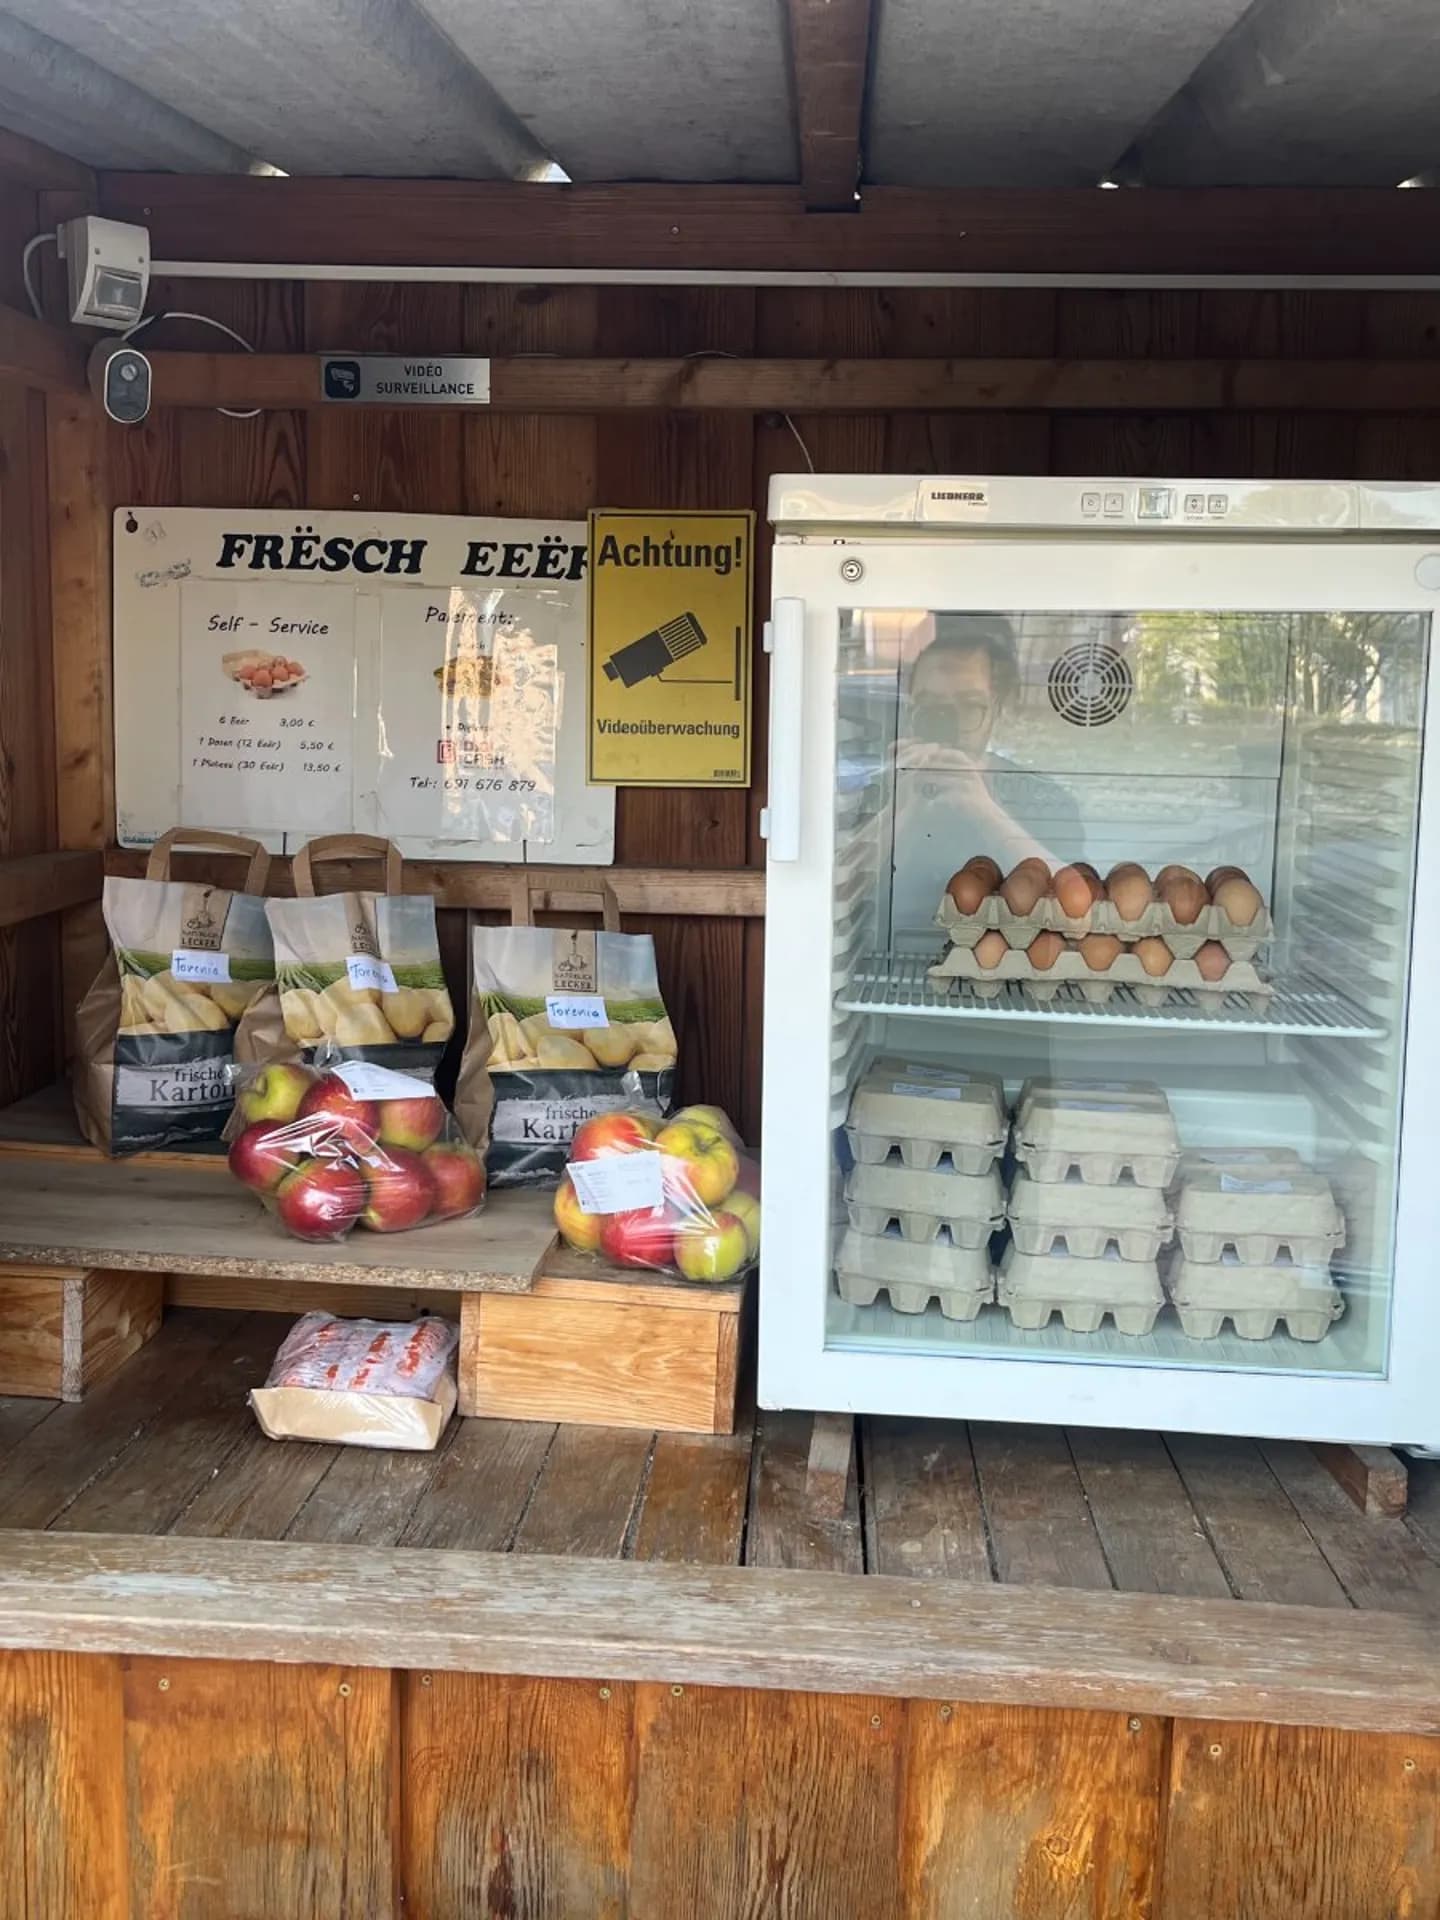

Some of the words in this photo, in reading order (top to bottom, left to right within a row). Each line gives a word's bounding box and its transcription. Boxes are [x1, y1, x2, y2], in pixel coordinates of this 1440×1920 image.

[404, 362, 443, 377] VIDÉO
[376, 382, 475, 395] SURVEILLANCE
[216, 526, 428, 574] FRËSCH
[598, 535, 742, 575] Achtung!
[208, 614, 244, 632] Self
[269, 617, 329, 634] Service
[280, 718, 304, 728] 3,00
[597, 719, 740, 739] Videoüberwachung
[300, 741, 324, 751] 5,50
[304, 763, 331, 773] 13,50
[444, 778, 469, 790] 691
[475, 779, 503, 791] 676
[508, 780, 537, 792] 879
